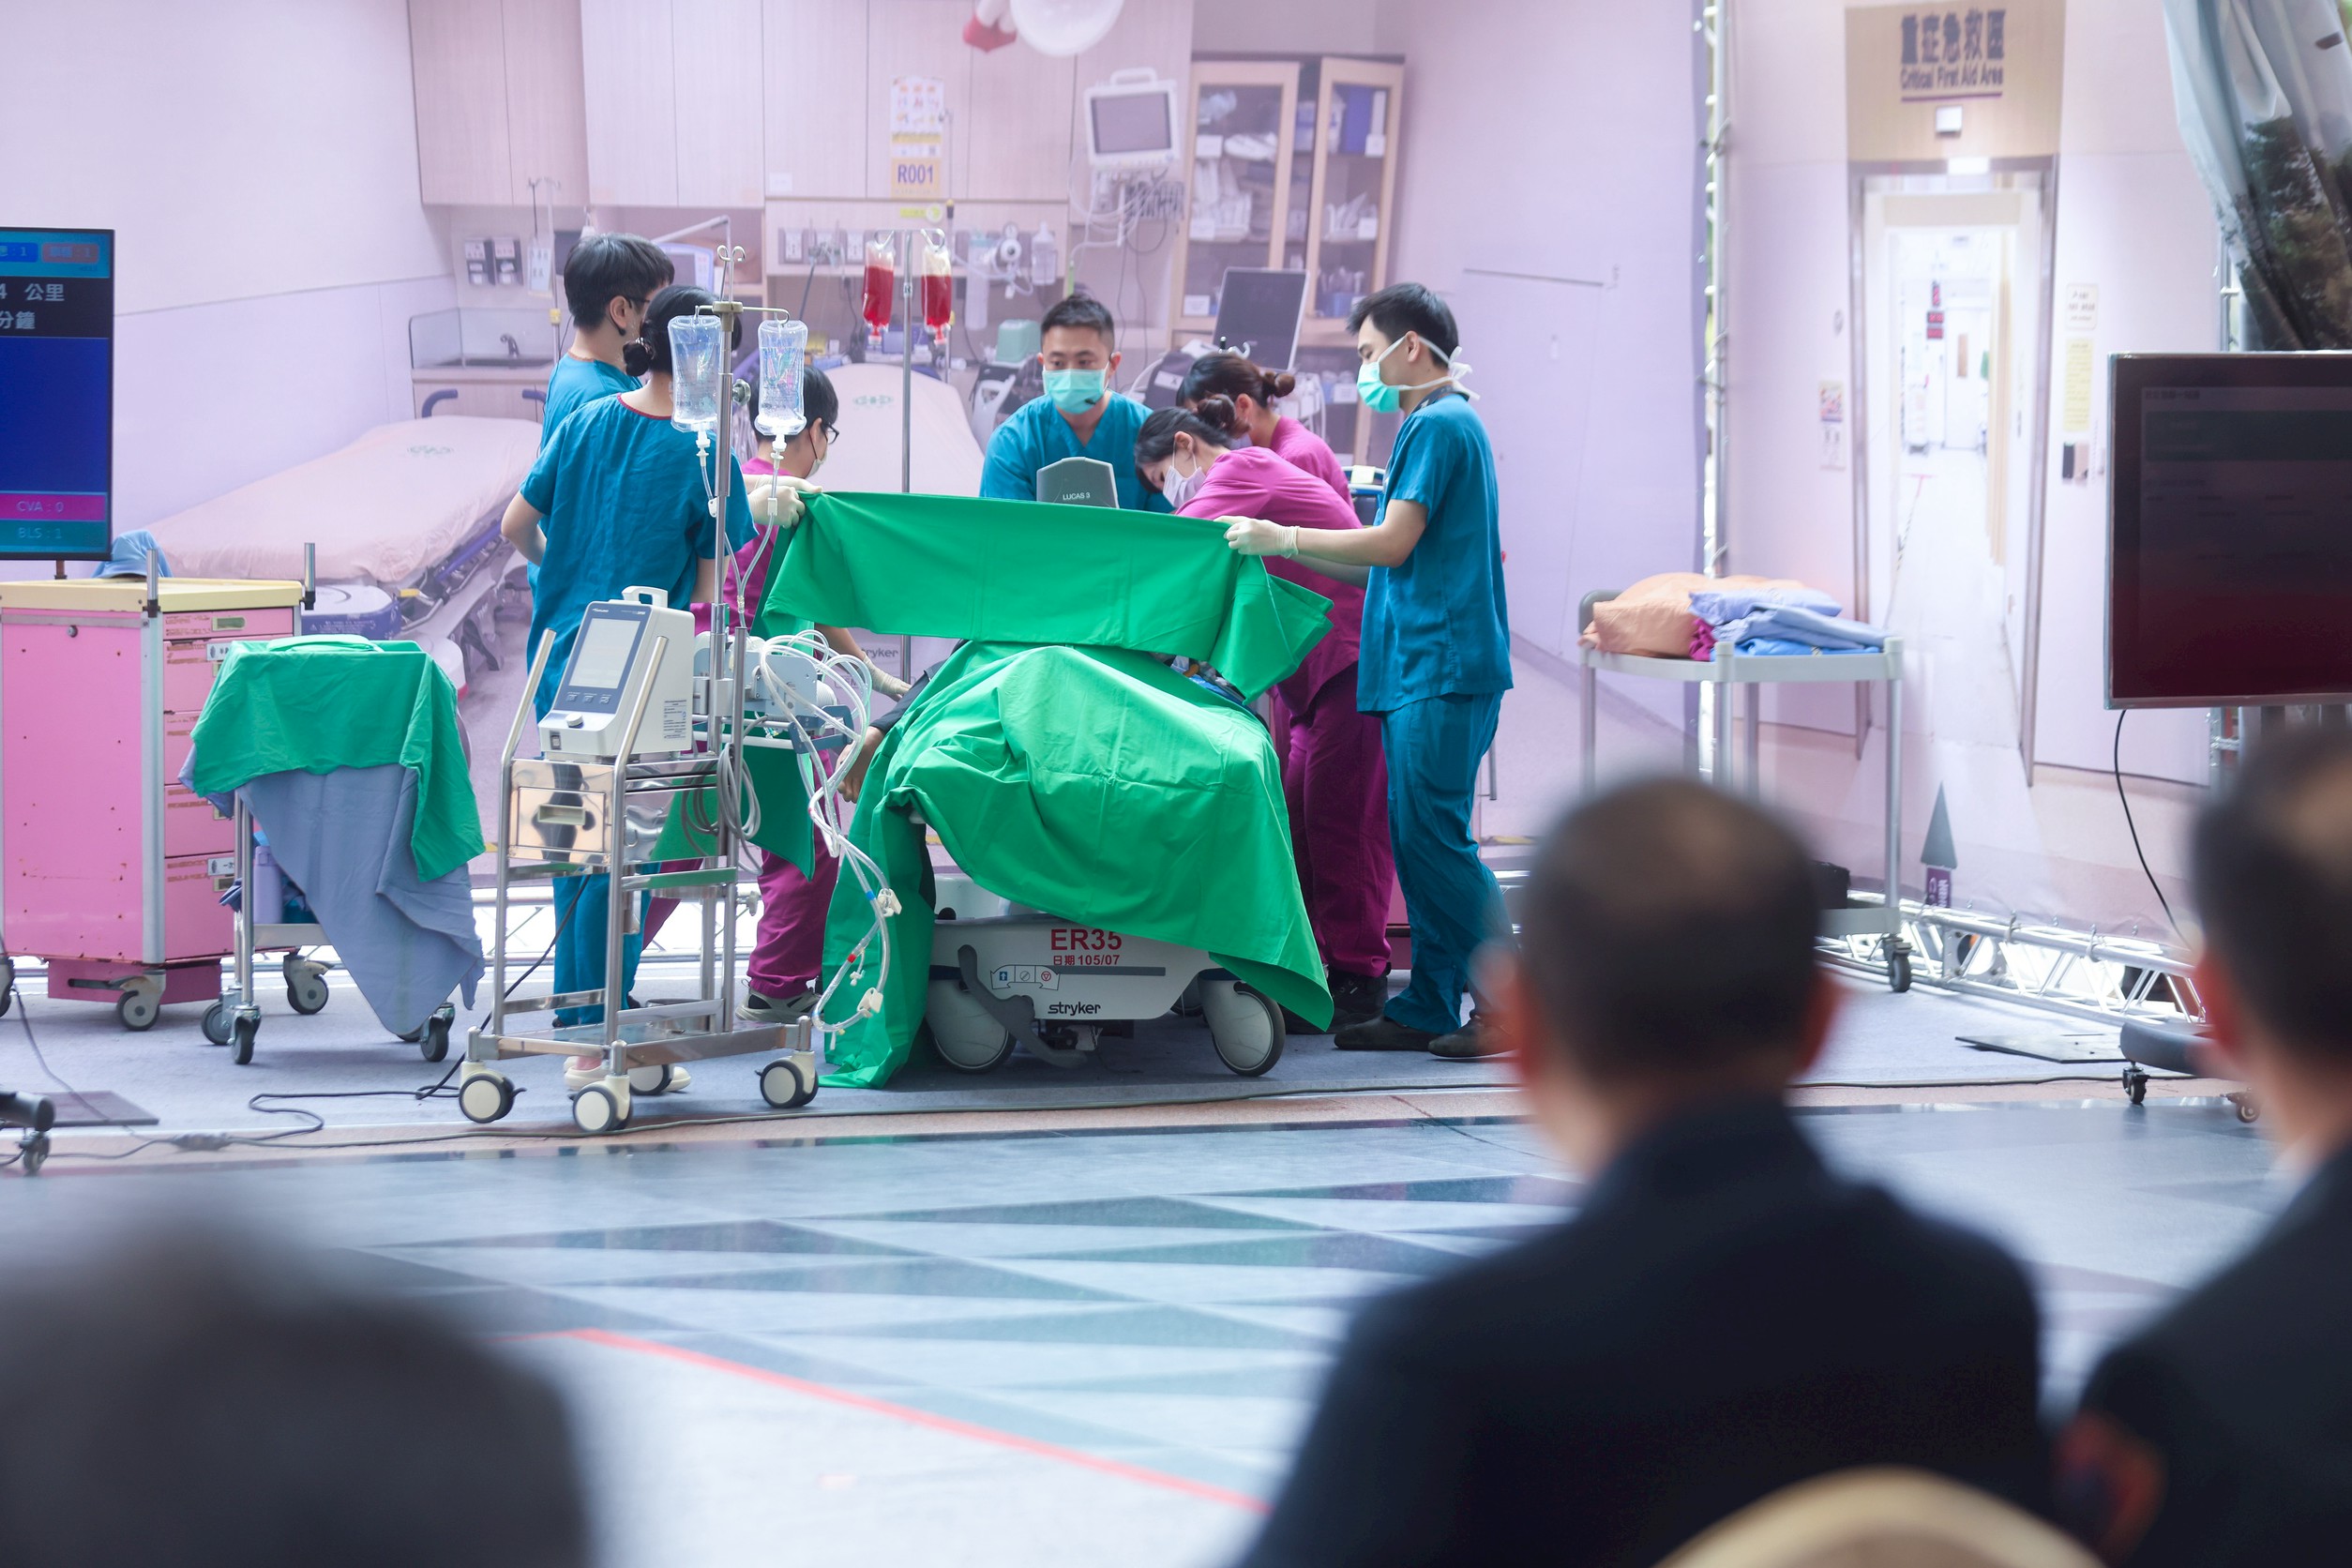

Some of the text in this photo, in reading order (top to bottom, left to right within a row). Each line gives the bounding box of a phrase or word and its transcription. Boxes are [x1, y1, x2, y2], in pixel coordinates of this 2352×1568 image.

[1900, 62, 2003, 89] Critical First Aid Area
[897, 164, 933, 184] R001
[24, 283, 65, 301] 公里
[0, 310, 36, 329] 分鐘
[1063, 492, 1085, 501] LUCAS
[17, 501, 43, 512] CVA
[19, 527, 43, 539] BLS
[1051, 928, 1123, 951] ER35
[1053, 954, 1121, 966] 日期 105/07
[1048, 1002, 1101, 1016] stryker
